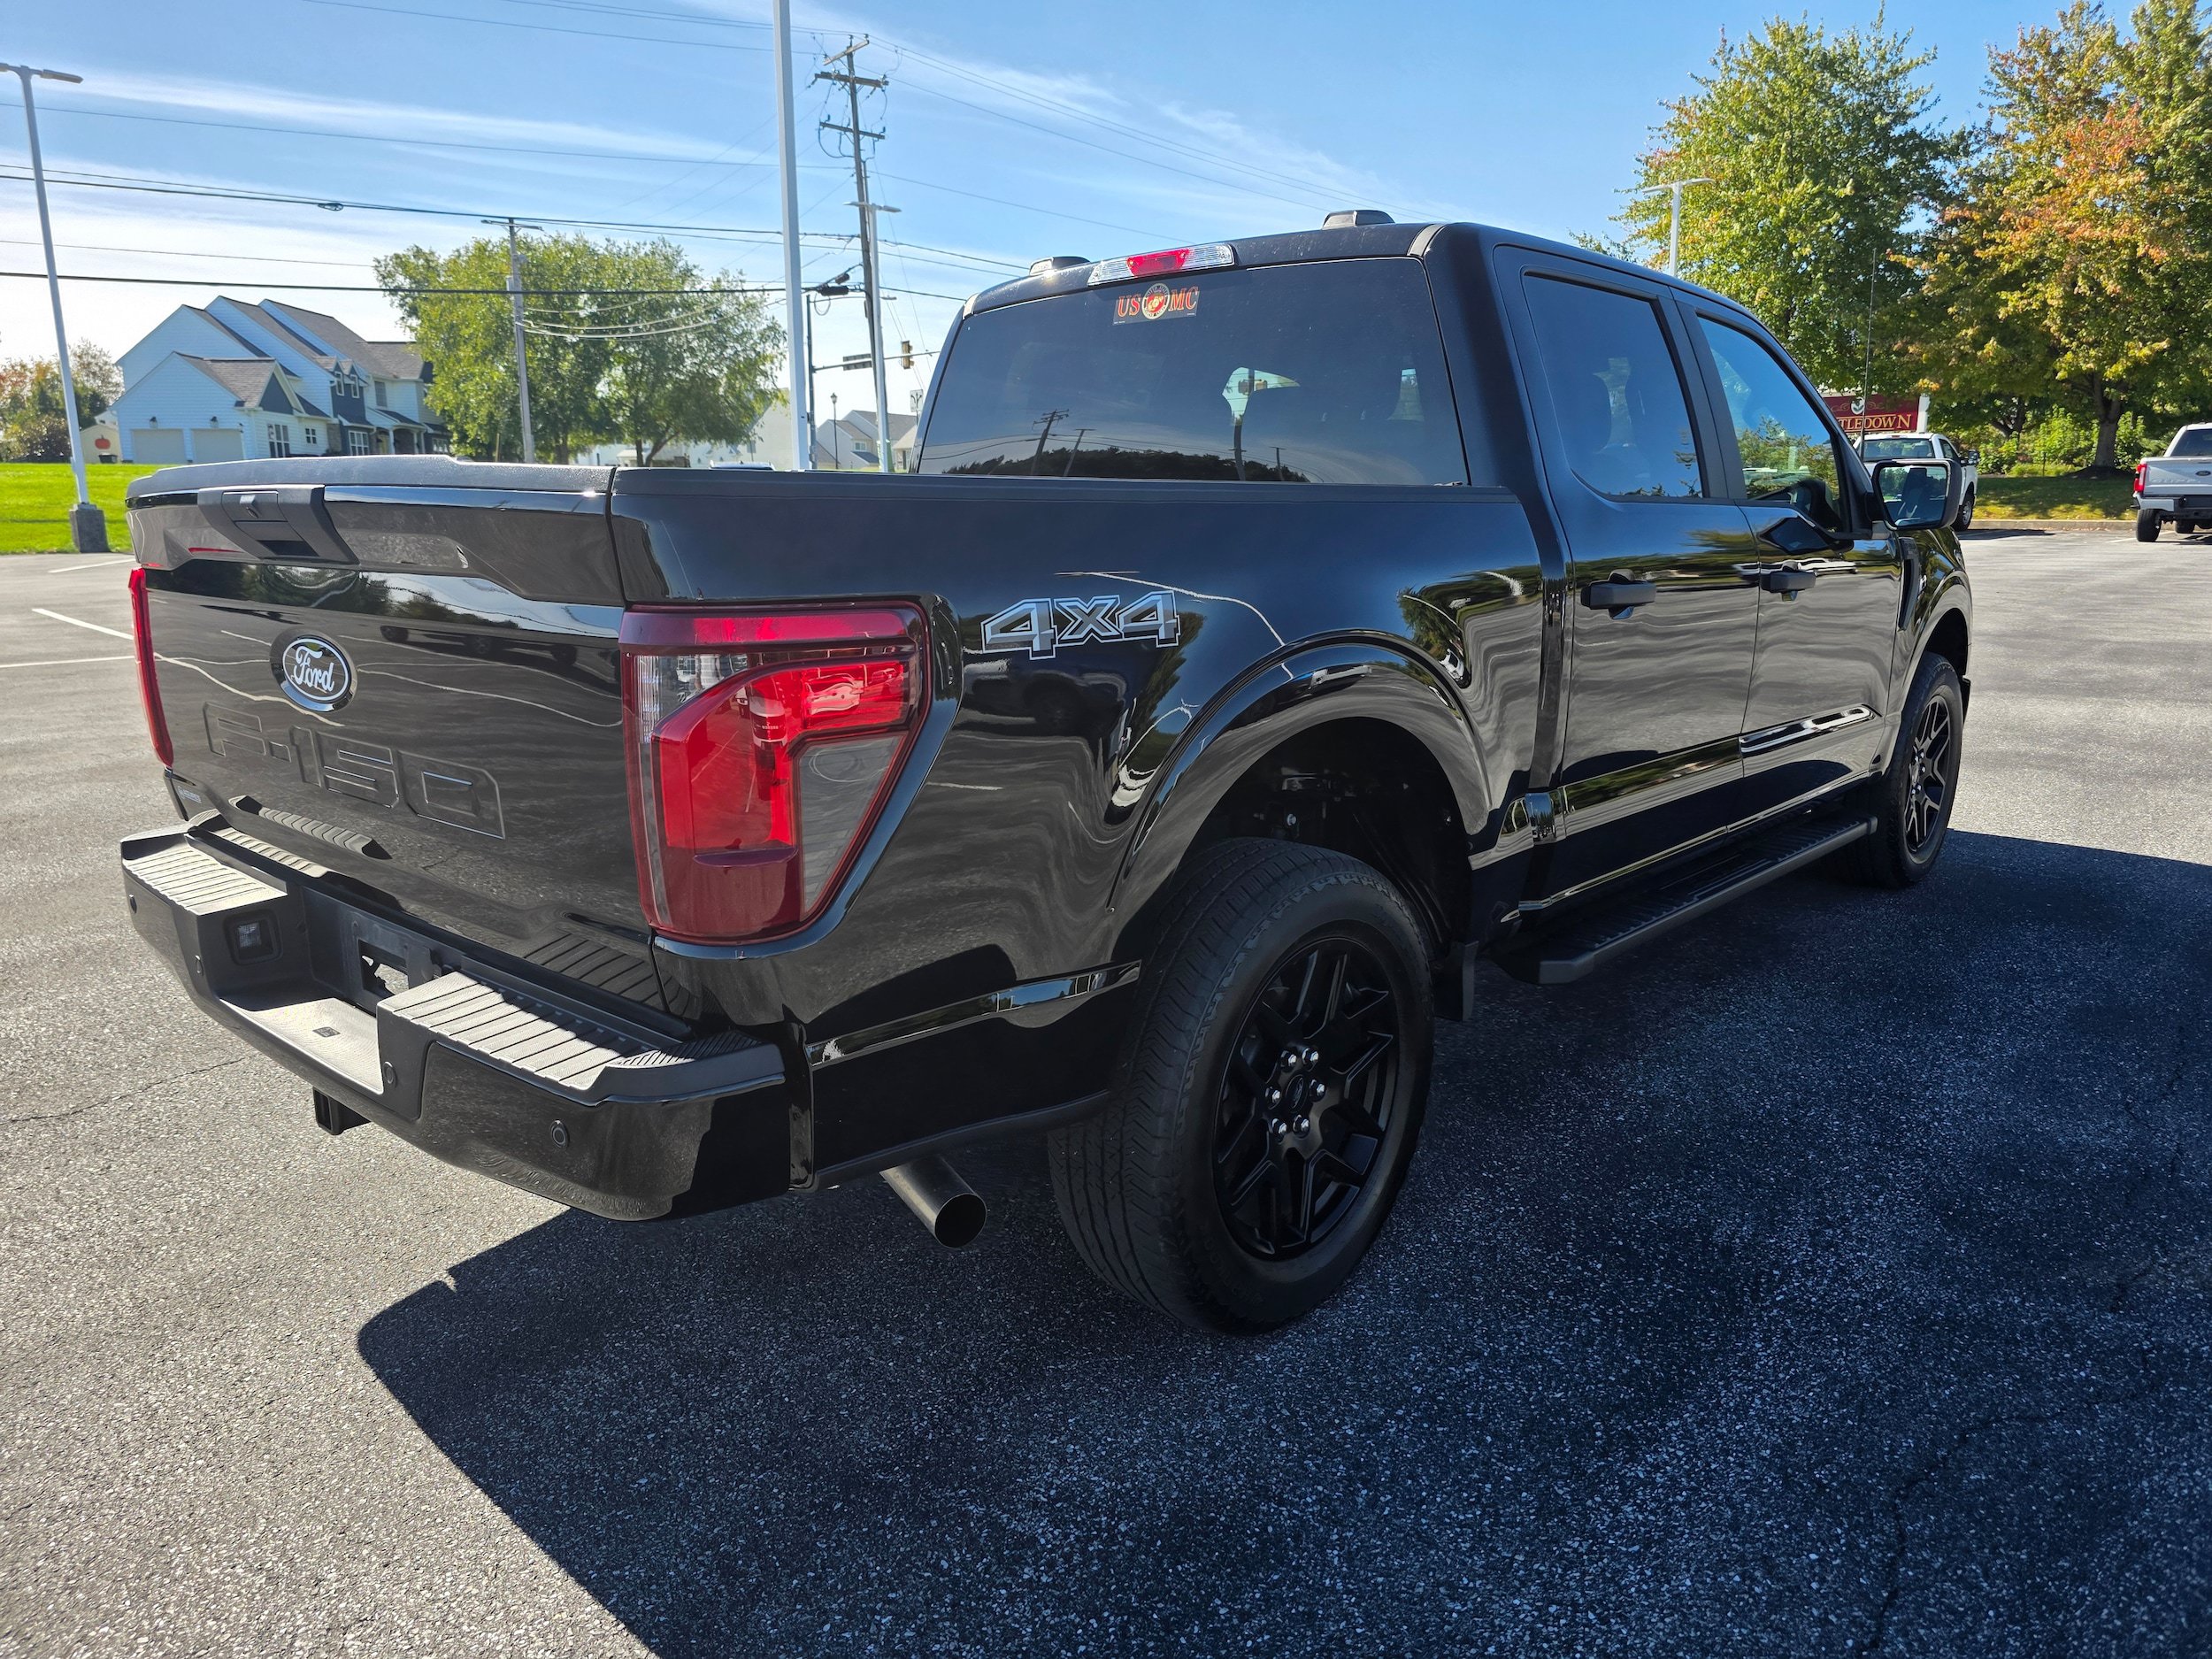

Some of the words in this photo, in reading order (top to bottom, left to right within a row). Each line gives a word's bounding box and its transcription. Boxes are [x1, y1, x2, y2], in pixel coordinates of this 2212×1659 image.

[1840, 413, 1912, 430] TLEDOWN
[294, 645, 335, 692] Ford
[204, 702, 507, 840] F-150
